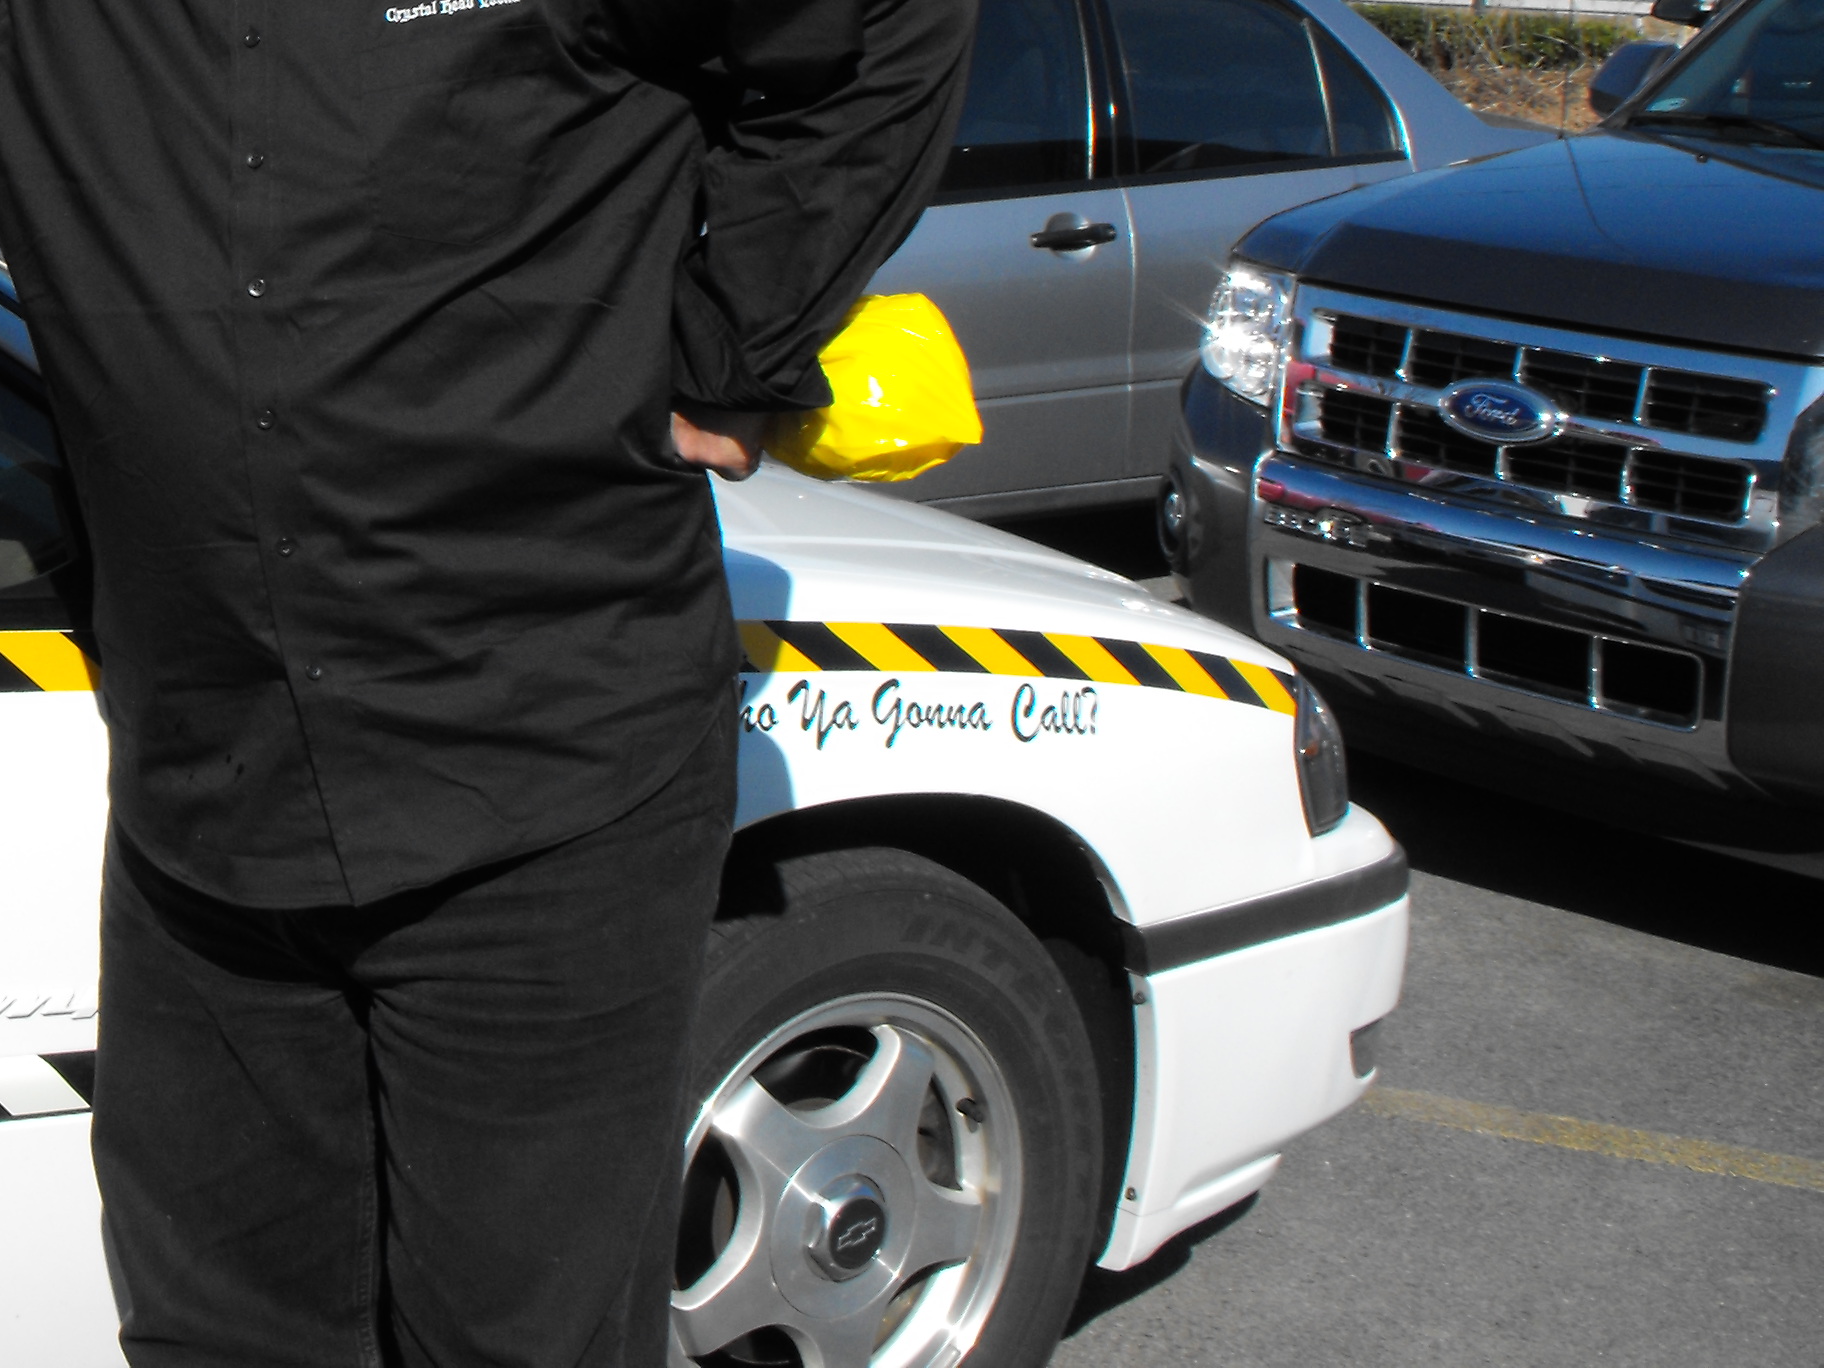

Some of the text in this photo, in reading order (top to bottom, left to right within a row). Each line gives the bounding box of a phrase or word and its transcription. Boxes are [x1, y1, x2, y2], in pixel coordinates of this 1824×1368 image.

[384, 0, 438, 24] Crystal
[1464, 393, 1520, 425] Ford
[738, 678, 1098, 750] ho Ya Gonna Call?
